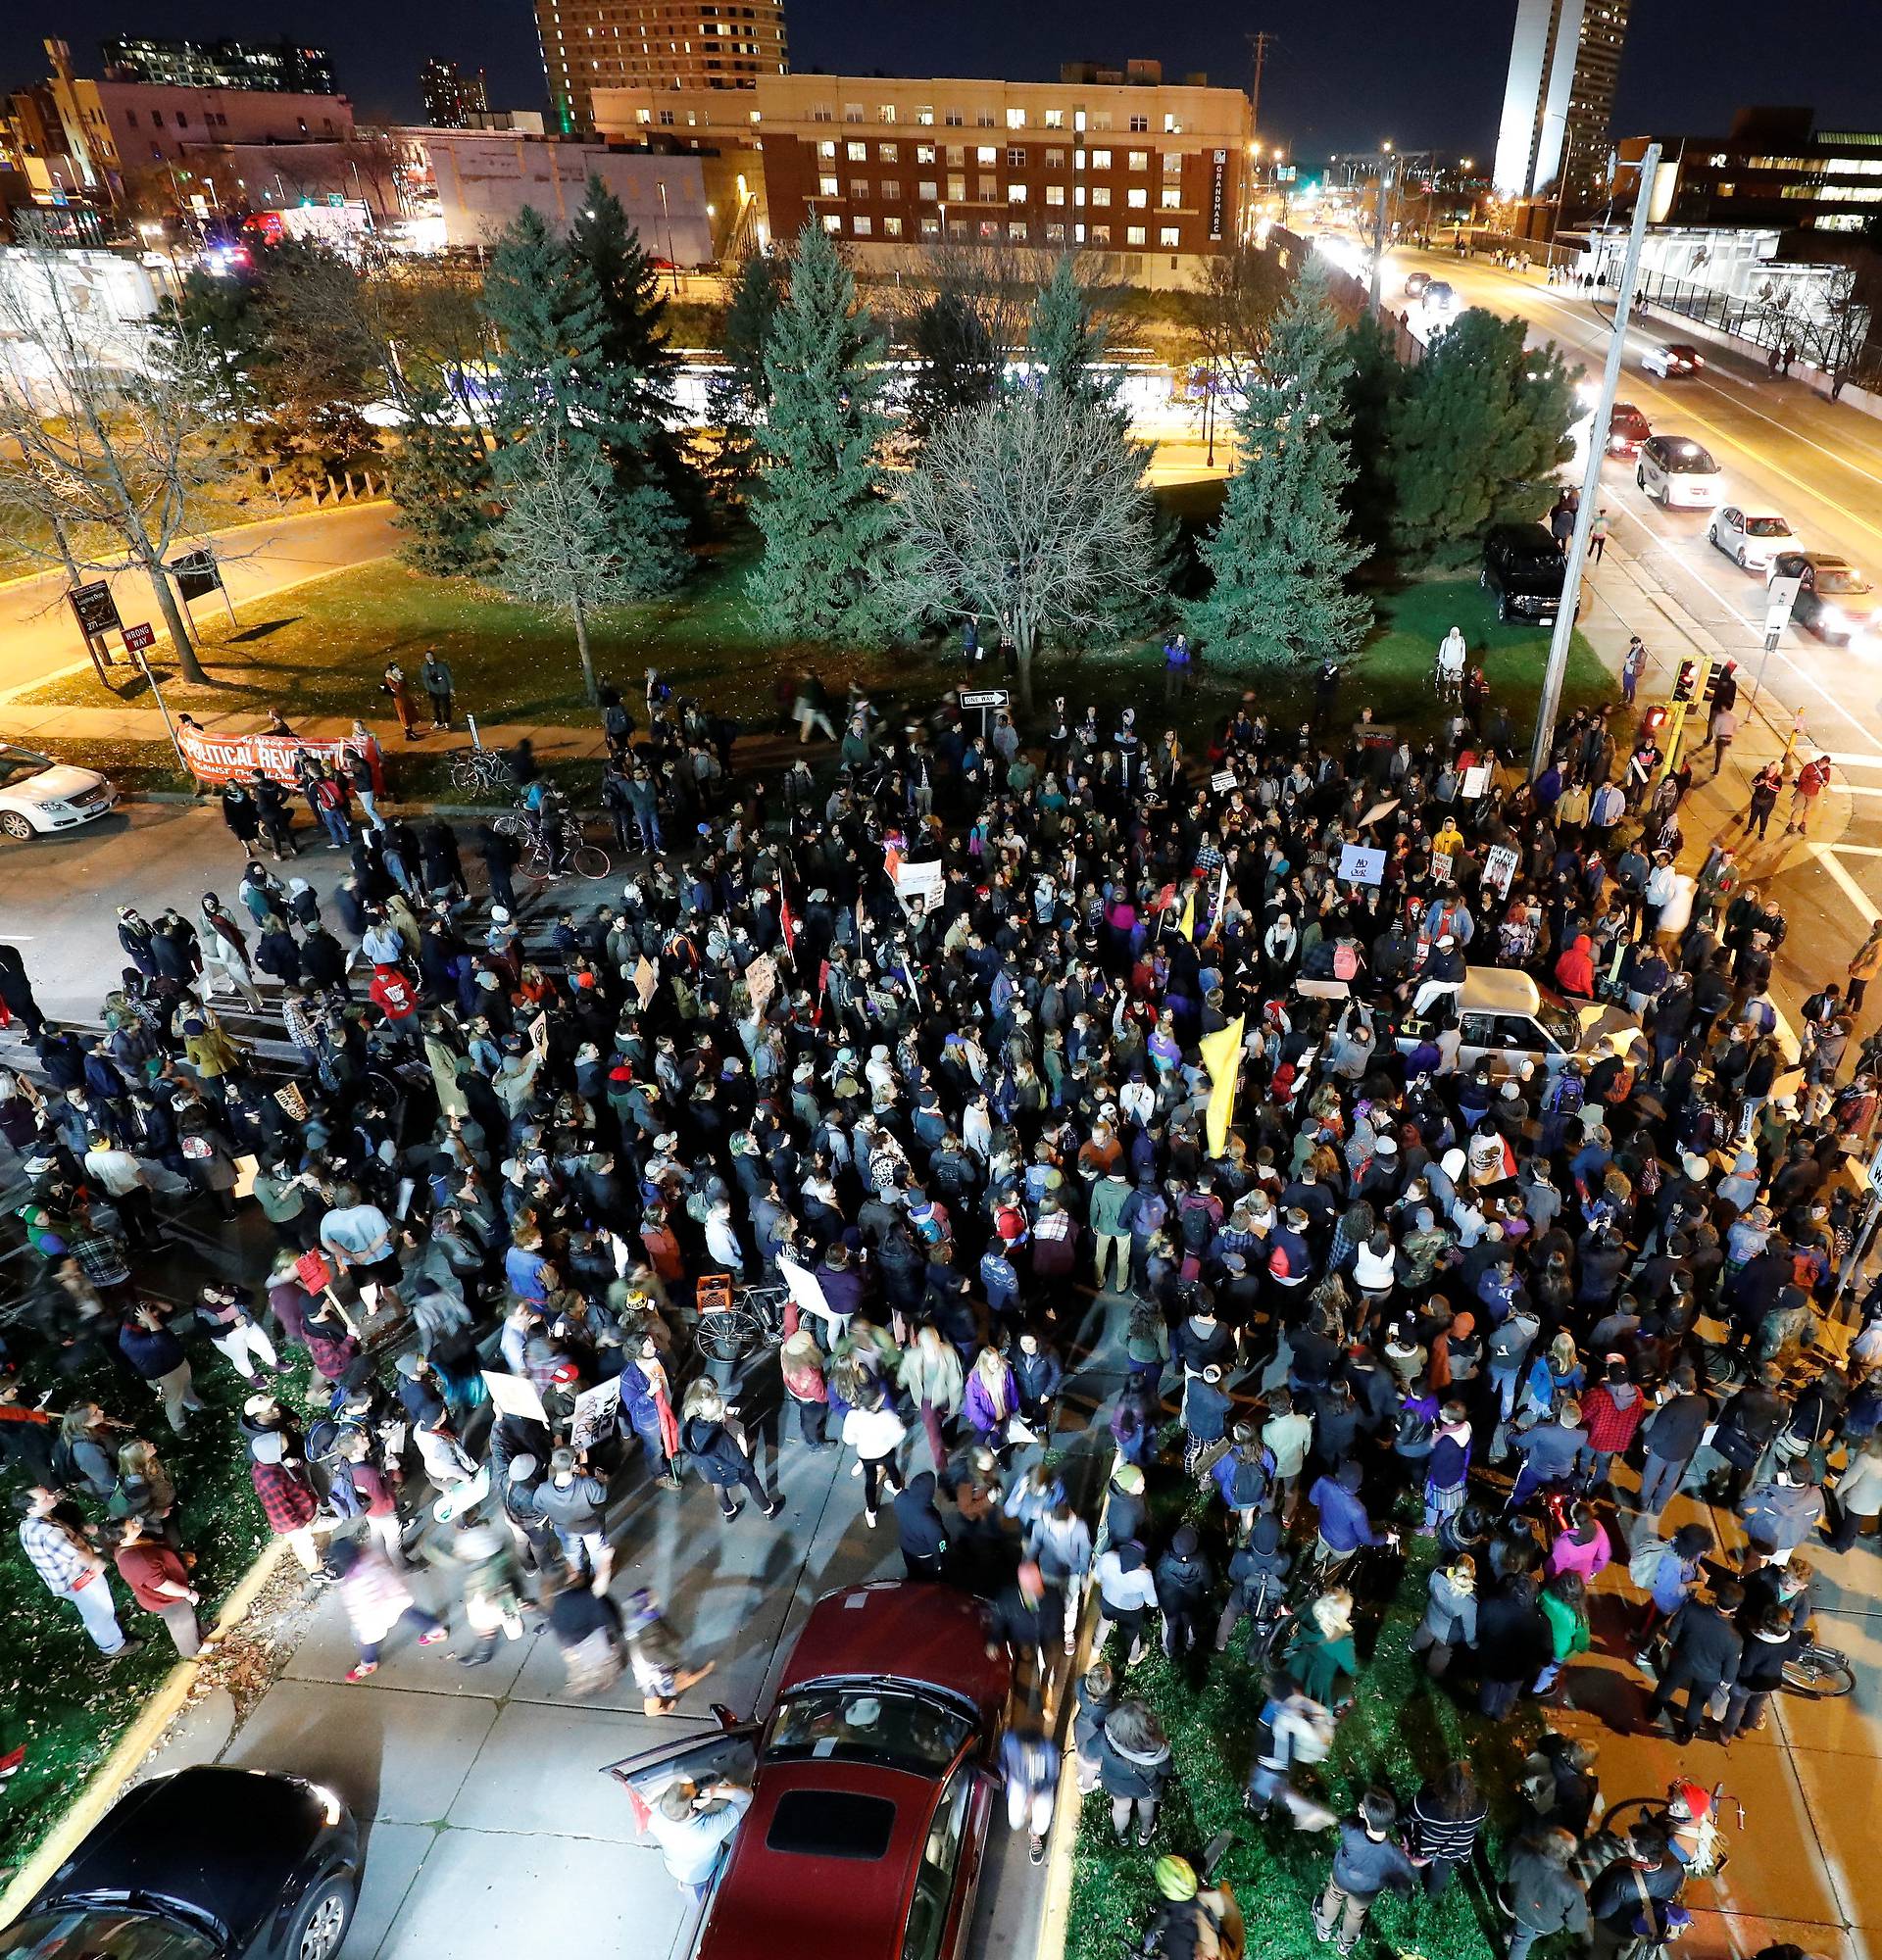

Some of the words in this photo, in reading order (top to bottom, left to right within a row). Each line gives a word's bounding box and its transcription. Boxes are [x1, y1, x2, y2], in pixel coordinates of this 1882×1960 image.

[1213, 165, 1222, 232] GRANDMARC
[124, 625, 150, 641] WRONG
[132, 636, 148, 648] WAY
[184, 737, 258, 767] POLITICAL
[192, 760, 231, 775] AGAINST
[276, 1092, 290, 1107] NOT
[289, 1107, 301, 1120] DO
